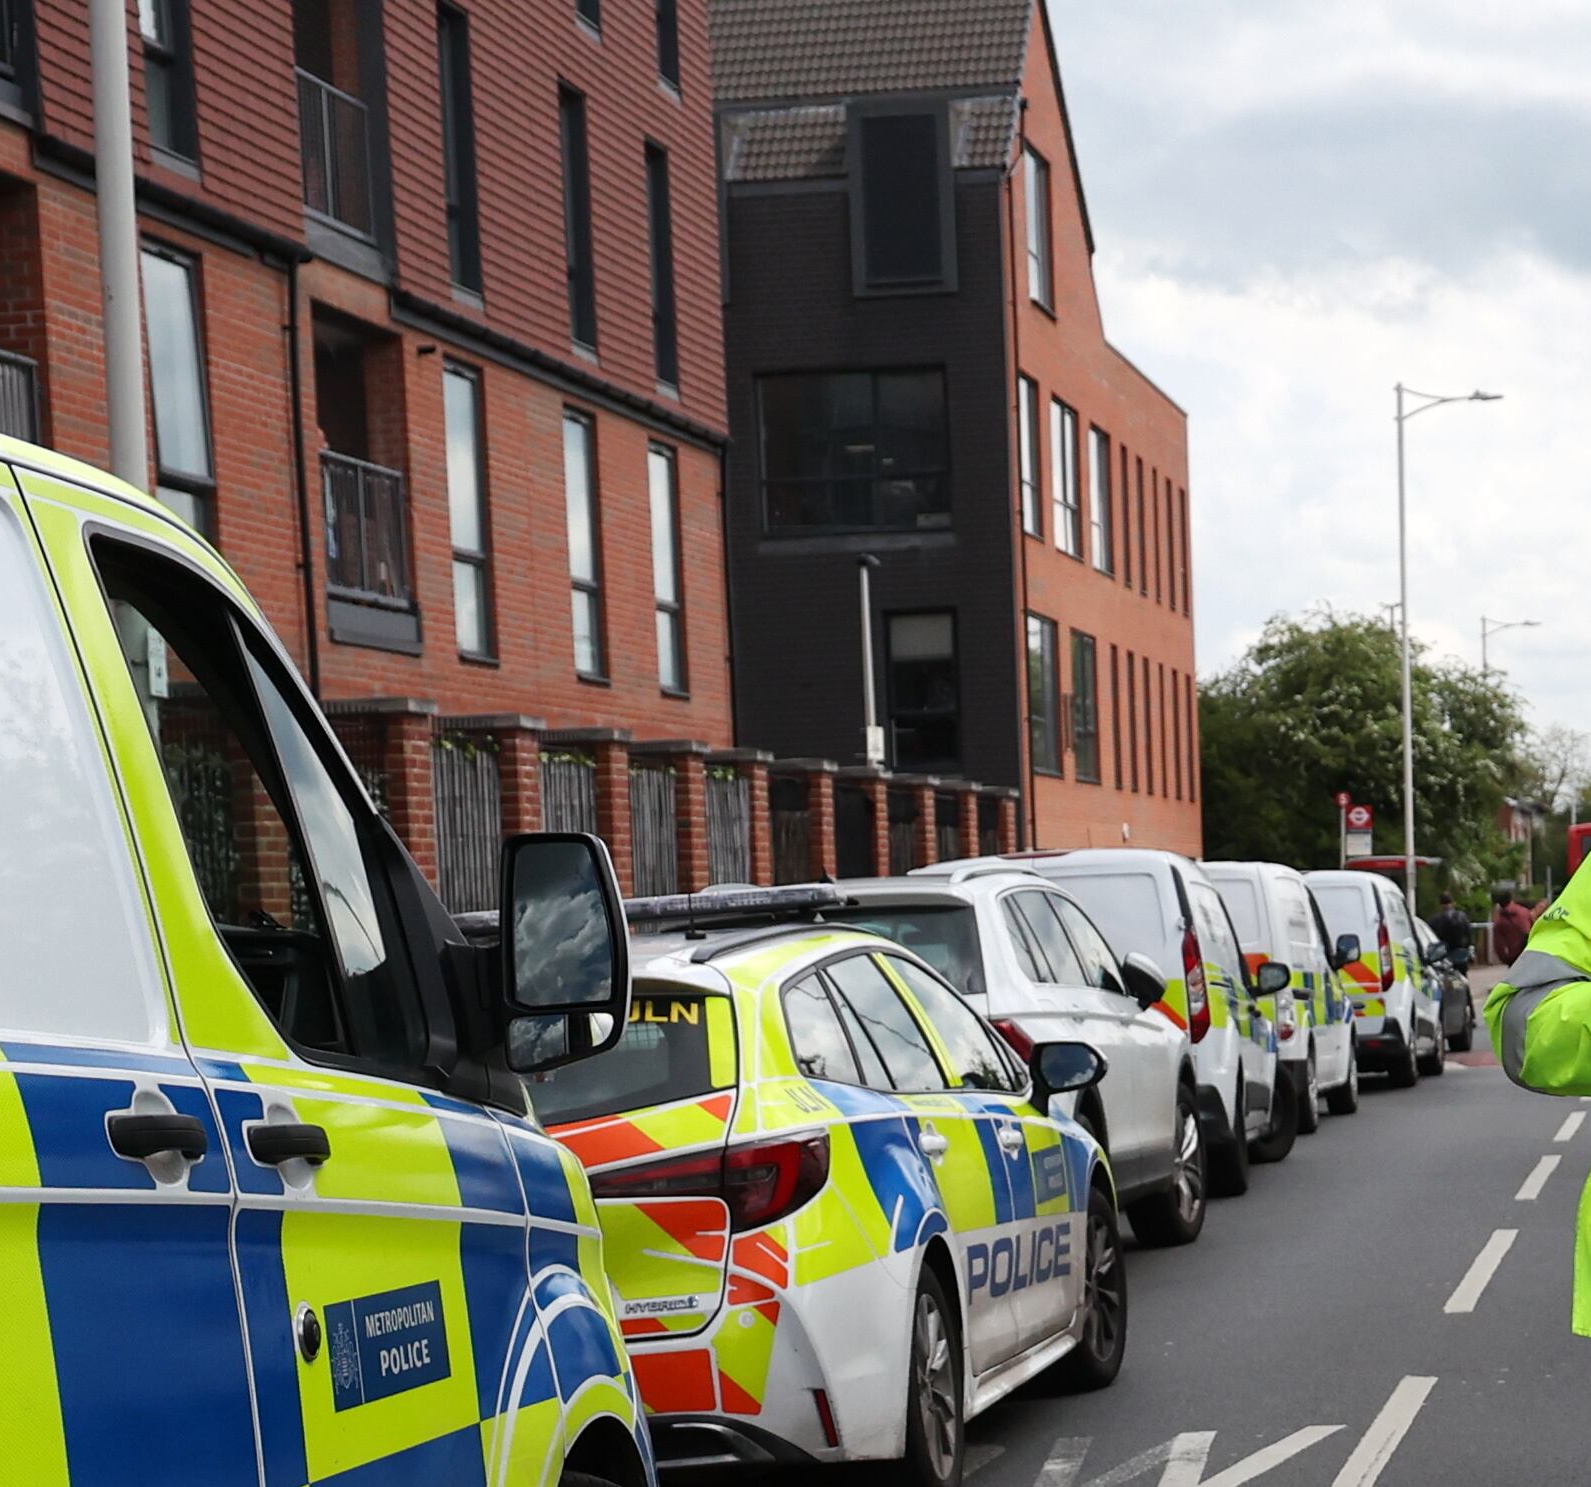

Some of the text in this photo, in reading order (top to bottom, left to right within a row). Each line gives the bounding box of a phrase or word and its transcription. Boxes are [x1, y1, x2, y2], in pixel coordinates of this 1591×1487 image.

[966, 1222, 1072, 1307] POLICE
[364, 1301, 435, 1339] METROPOLITAN
[379, 1339, 431, 1377] POLICE
